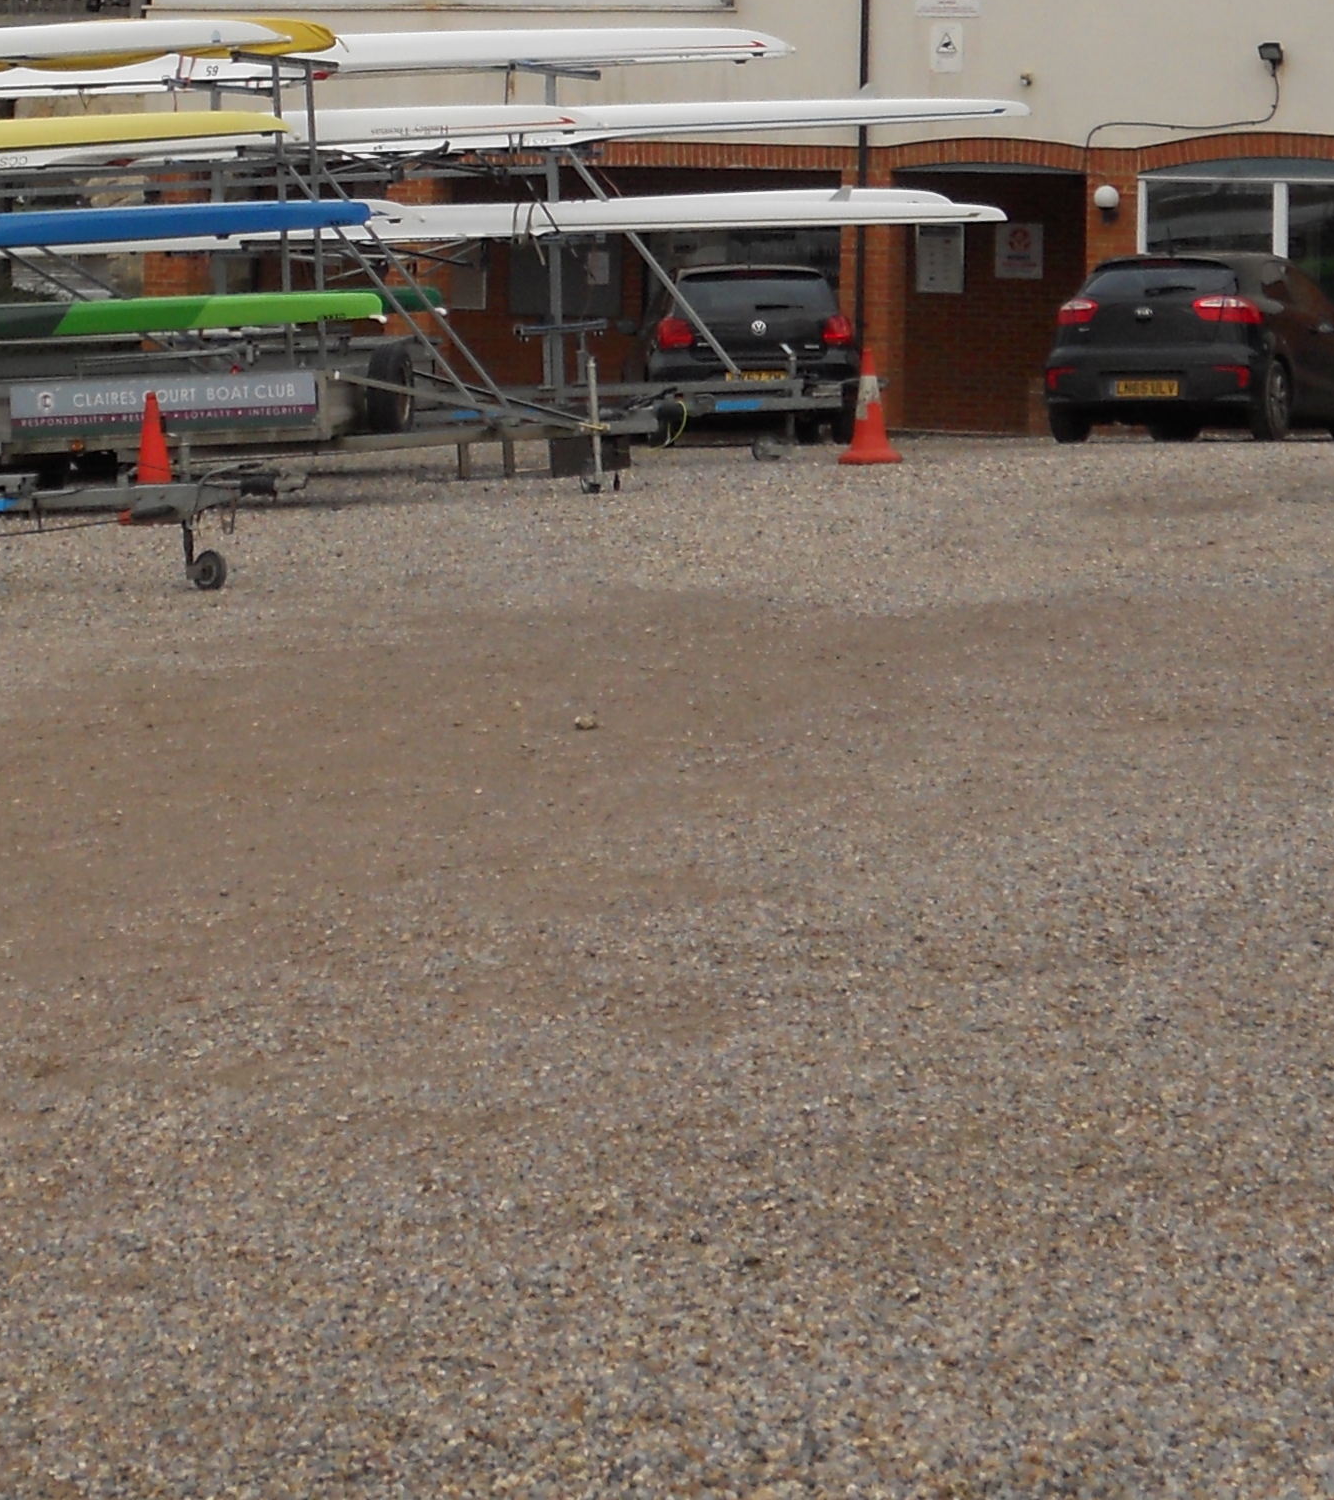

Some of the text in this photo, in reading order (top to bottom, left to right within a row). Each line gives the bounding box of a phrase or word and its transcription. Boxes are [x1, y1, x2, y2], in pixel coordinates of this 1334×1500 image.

[73, 391, 136, 408] CLAIRES
[206, 386, 249, 401] BOAT
[255, 384, 295, 399] CLUB
[21, 416, 104, 427] RESPONSIBILITY
[184, 410, 231, 420] LOYALTY
[248, 406, 304, 416] INTEGRITY
